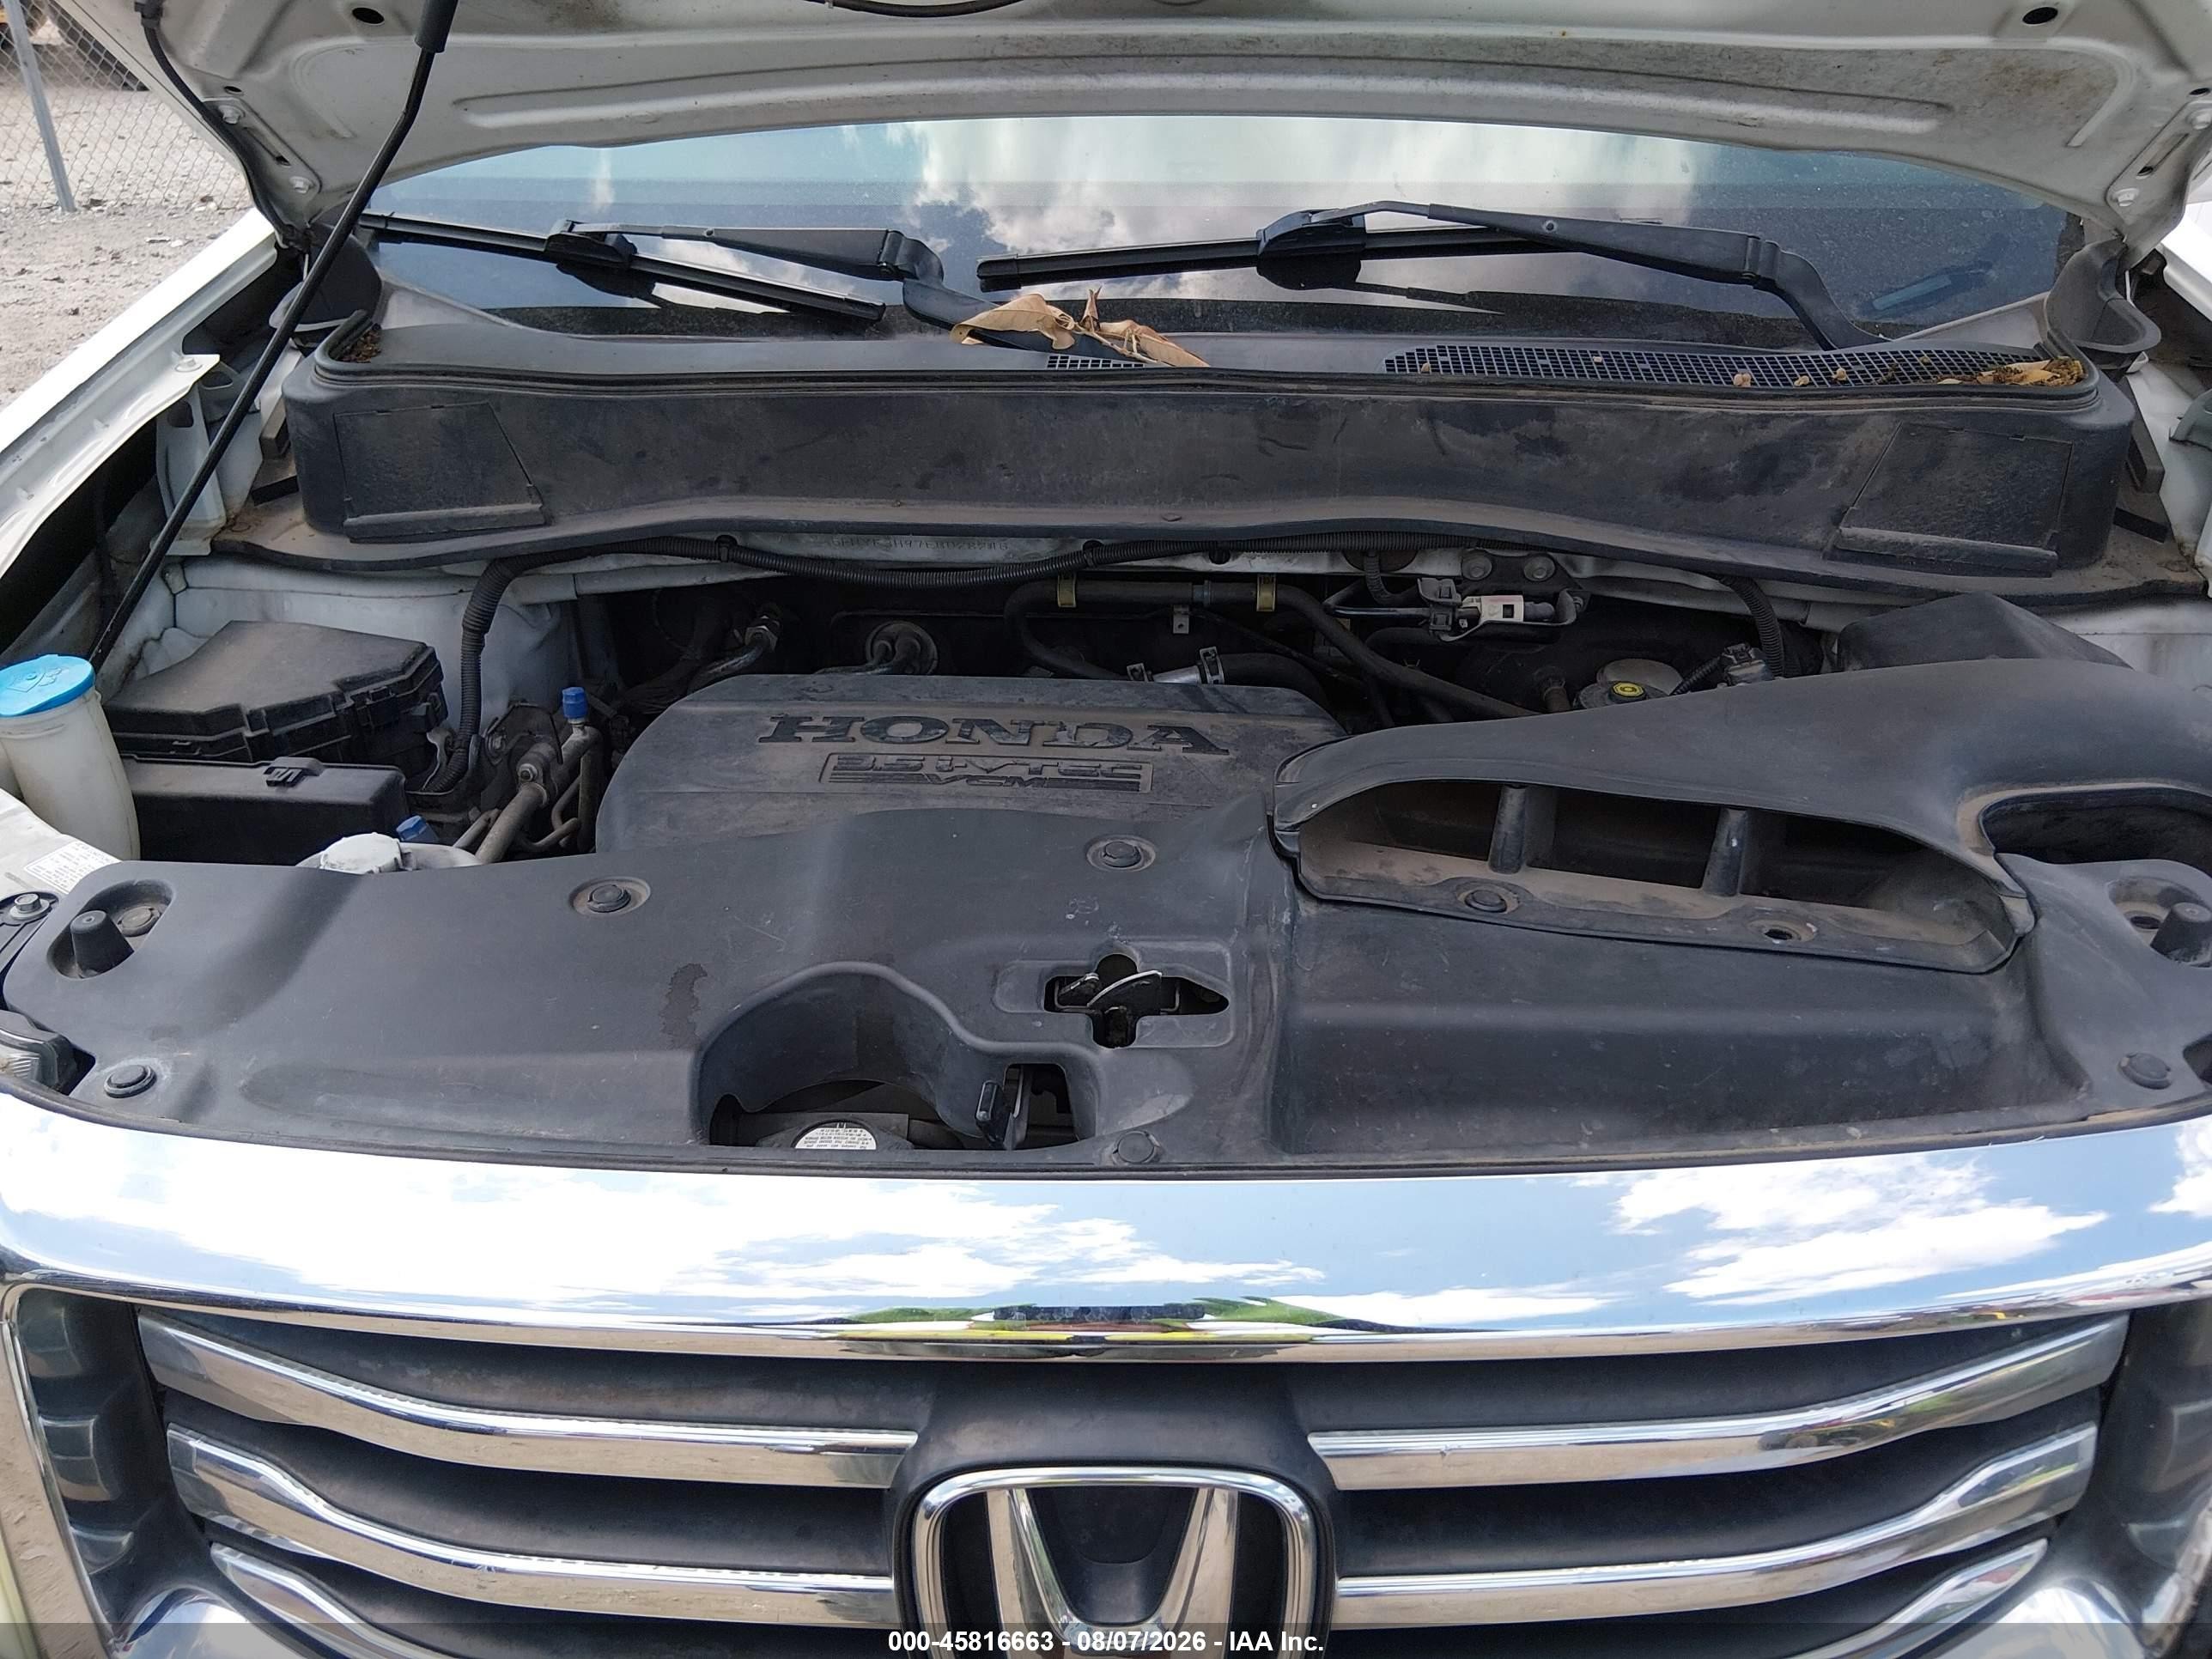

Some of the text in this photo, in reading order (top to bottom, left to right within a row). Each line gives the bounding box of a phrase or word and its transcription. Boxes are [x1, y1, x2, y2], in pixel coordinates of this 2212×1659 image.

[757, 715, 1230, 756] HONDA
[832, 753, 926, 772] 3.5
[921, 773, 1048, 789] VCM
